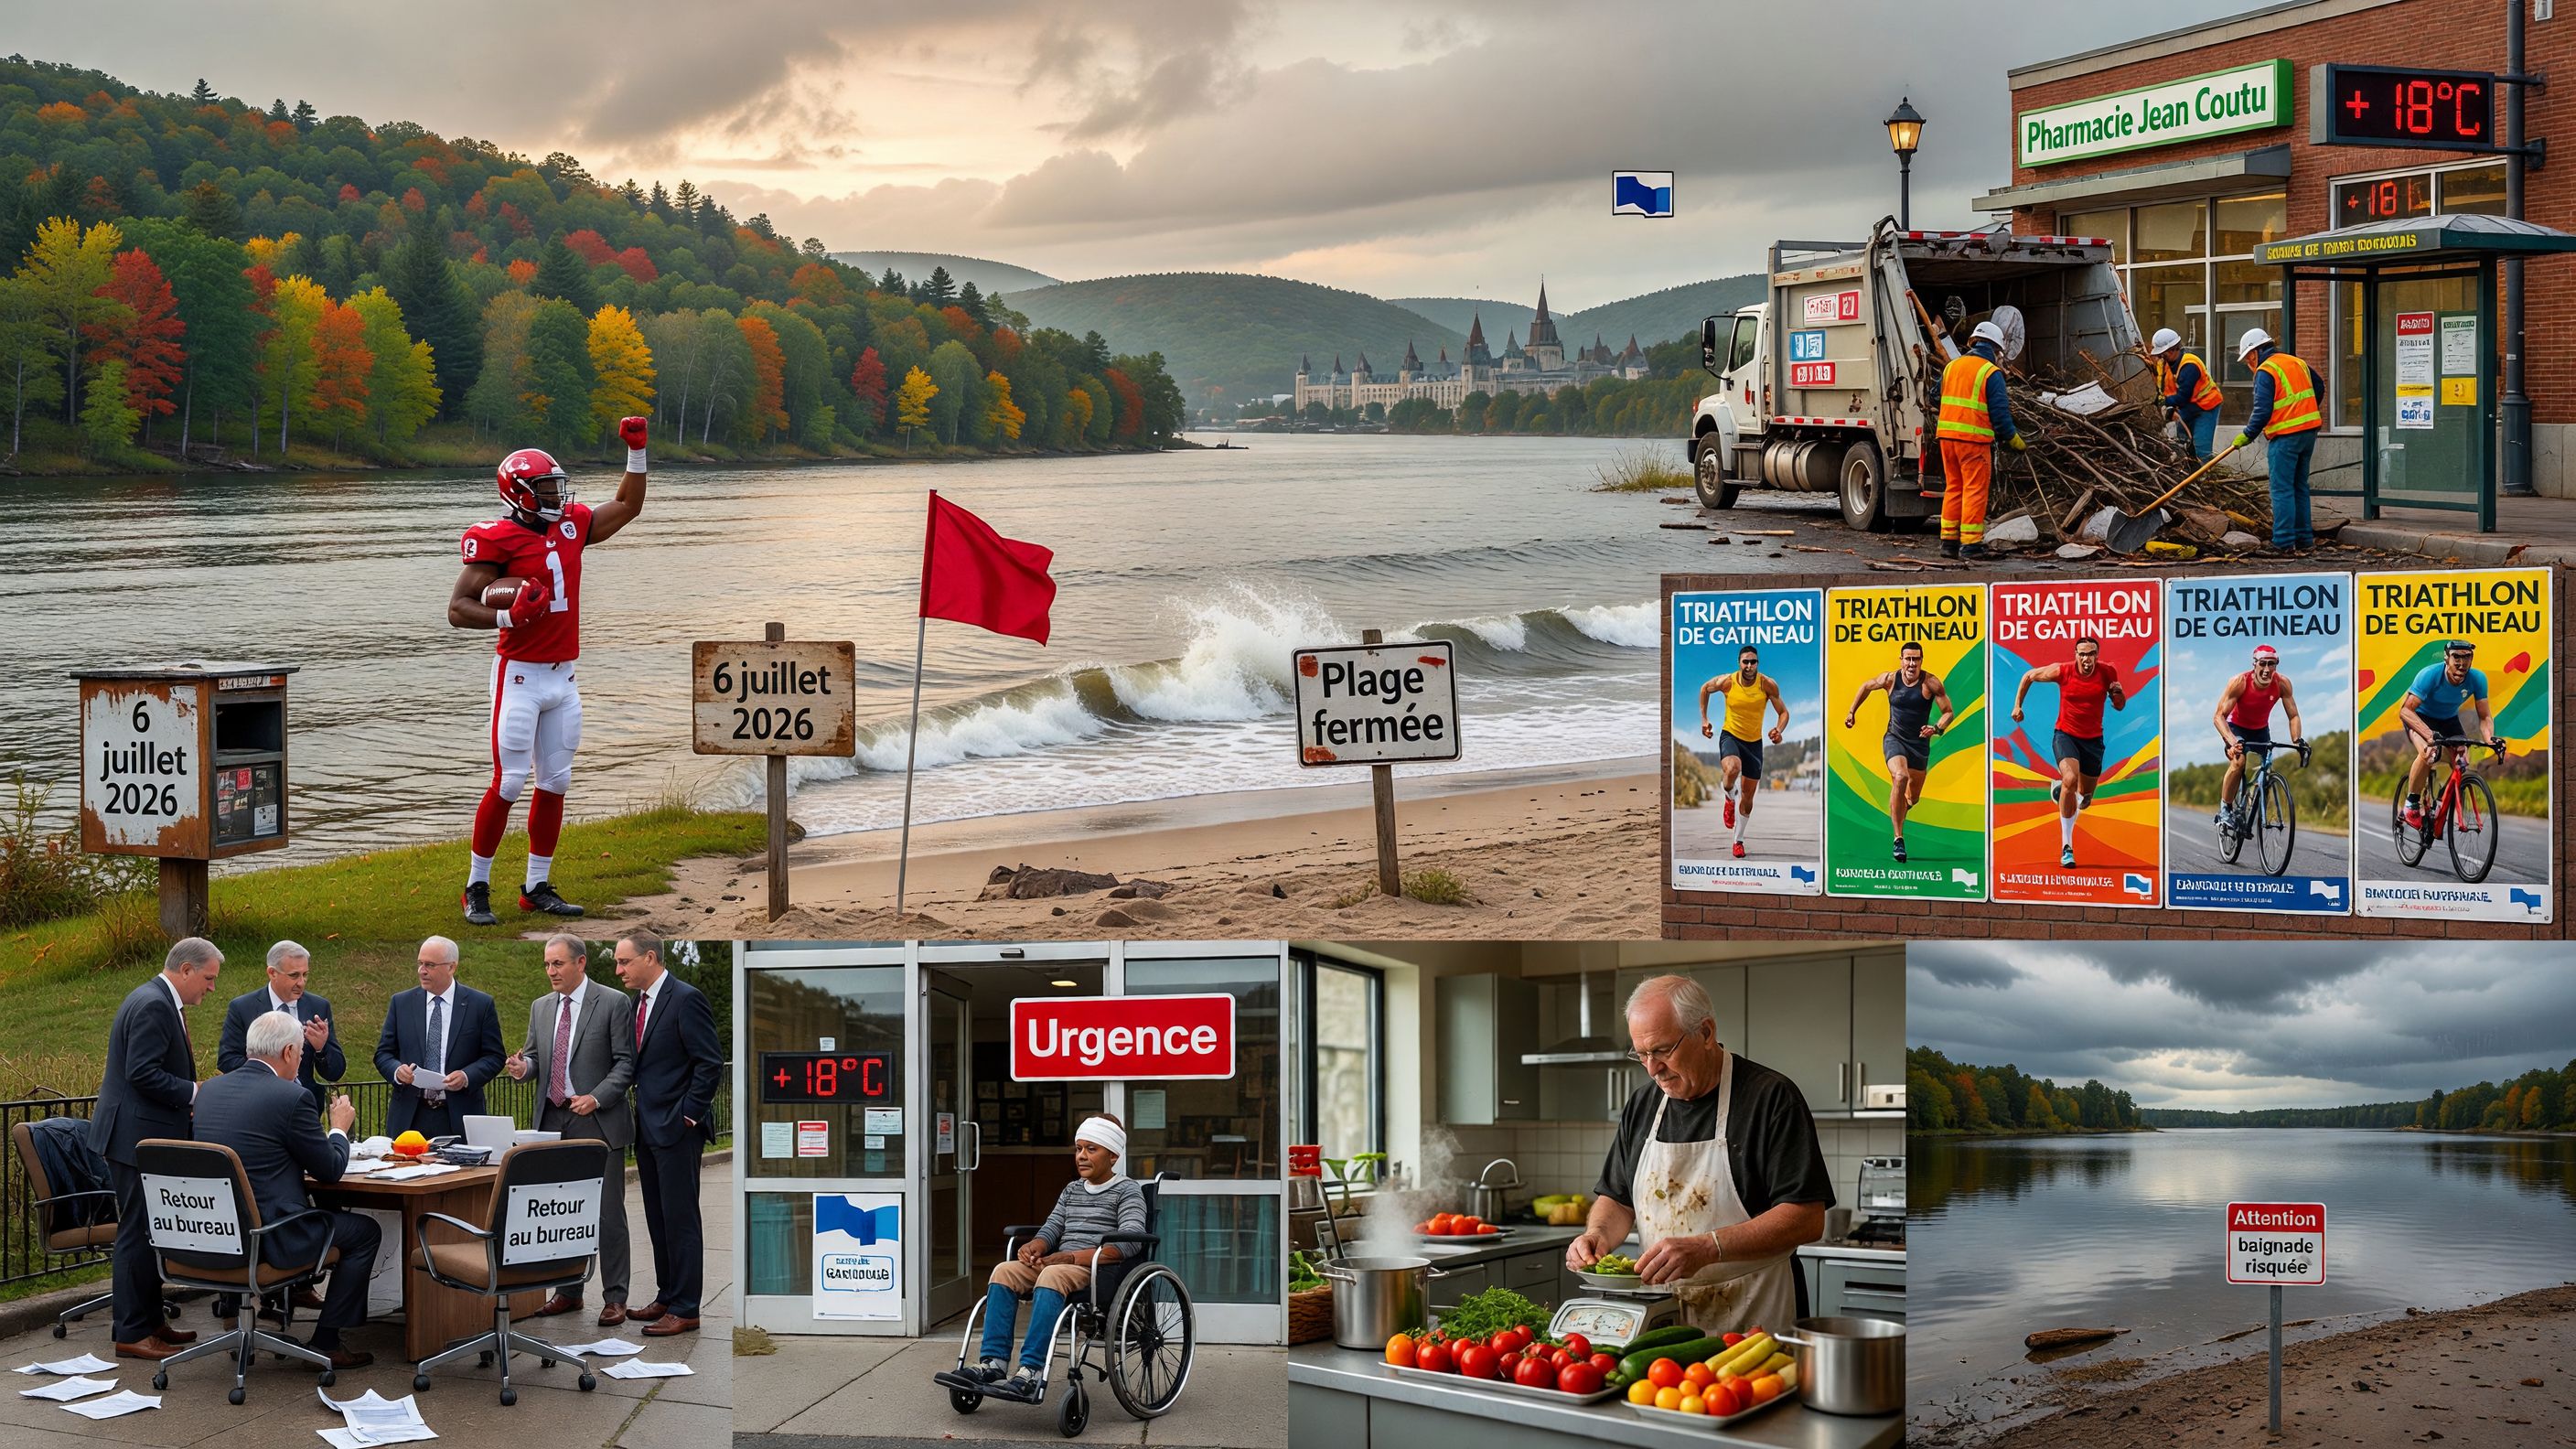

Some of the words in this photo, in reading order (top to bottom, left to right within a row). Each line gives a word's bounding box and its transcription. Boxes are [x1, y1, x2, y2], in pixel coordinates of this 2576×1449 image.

[2027, 104, 2134, 154] Pharmacie
[2137, 98, 2190, 134] Jean
[2195, 82, 2267, 123] Coutu
[545, 551, 569, 613] 1
[2366, 579, 2539, 608] TRIATHLON
[1680, 598, 1812, 624] TRIATHLON
[1835, 594, 1977, 619] TRIATHLON
[2000, 589, 2151, 617] TRIATHLON
[2175, 584, 2339, 613] TRIATHLON
[1679, 627, 1706, 645] DE
[1709, 624, 1814, 645] GATINEAU
[1834, 623, 1863, 643] DE
[1867, 620, 1978, 644] GATINEAU
[1999, 620, 2029, 640] DE
[2034, 617, 2152, 640] GATINEAU
[2175, 617, 2207, 639] DE
[2213, 613, 2341, 638] GATINEAU
[2366, 613, 2399, 636] DE
[2405, 610, 2540, 635] GATINEAU
[713, 660, 734, 694] 6
[735, 660, 832, 703] juillet
[1322, 659, 1424, 703] Plage
[132, 700, 151, 734] 6
[732, 707, 814, 741] 2026
[1312, 703, 1444, 746] fermée
[100, 740, 188, 782] juillet
[104, 782, 178, 817] 2026
[1028, 1018, 1218, 1067] Urgence
[159, 1187, 216, 1210] Retour
[527, 1198, 585, 1218] Retour
[153, 1217, 174, 1231] au
[175, 1214, 236, 1237] bureau
[2234, 1209, 2316, 1227] Attention
[509, 1231, 529, 1247] au
[536, 1222, 596, 1245] bureau
[2238, 1237, 2313, 1257] baignade
[2245, 1258, 2308, 1278] risquée
